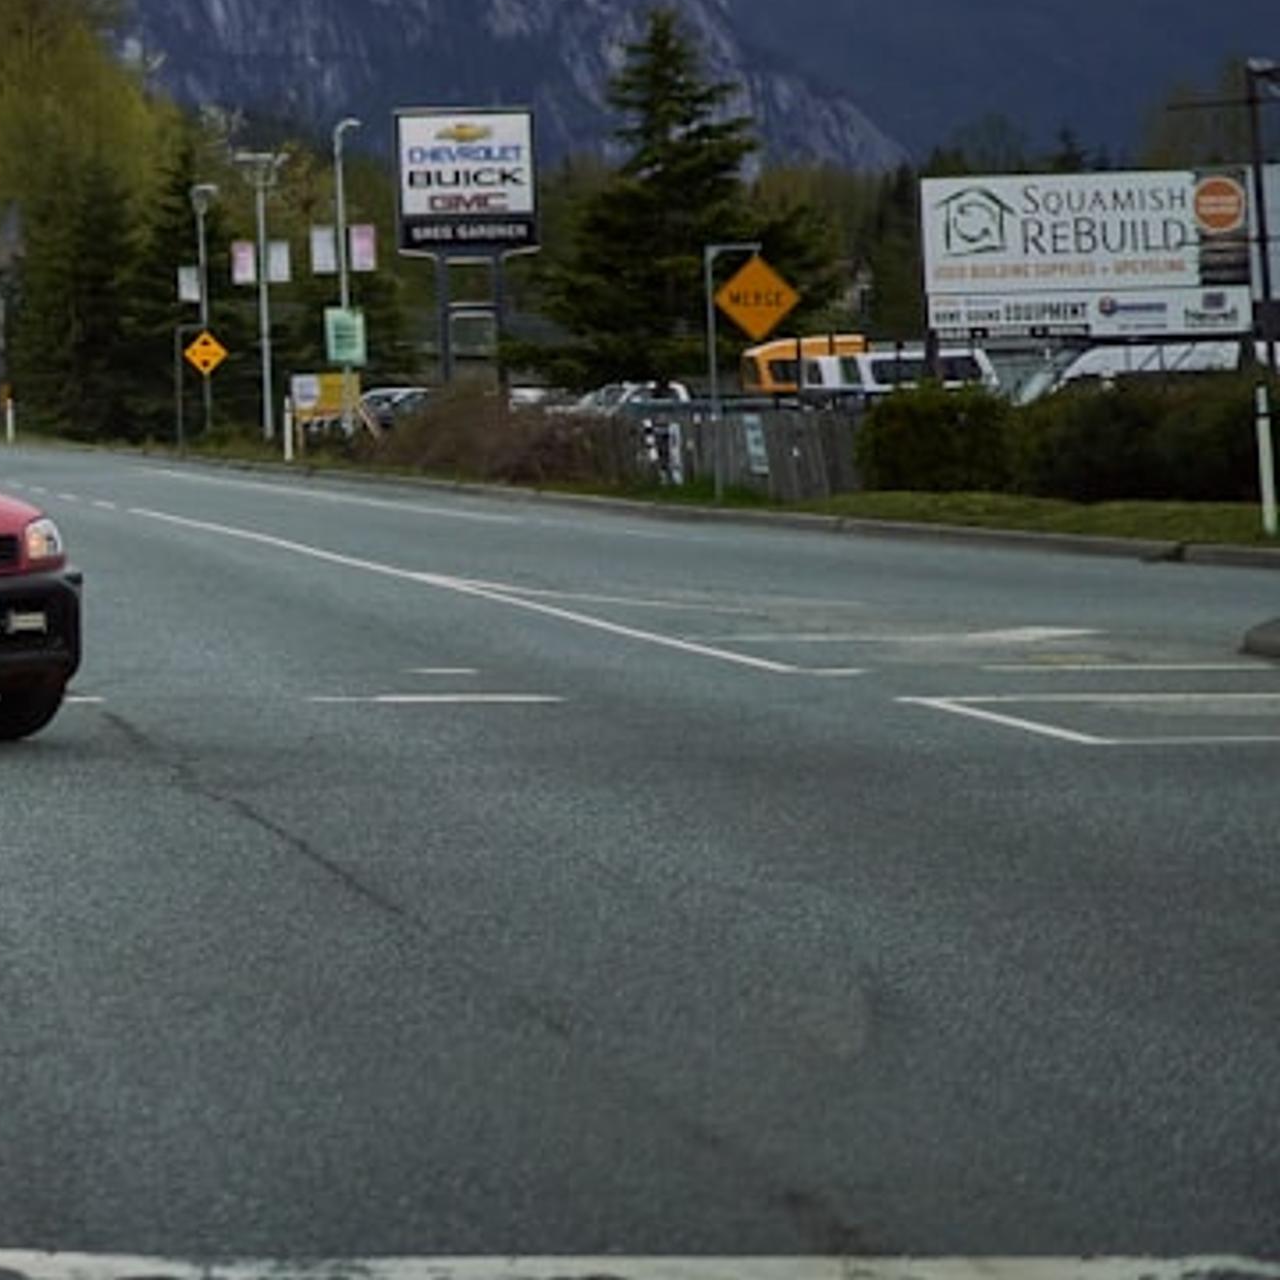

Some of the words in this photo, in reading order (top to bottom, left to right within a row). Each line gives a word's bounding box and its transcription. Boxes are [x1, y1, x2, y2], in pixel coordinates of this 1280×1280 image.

[409, 145, 521, 163] CHEVROLET
[409, 168, 525, 188] BUICK
[429, 192, 508, 211] GMC
[1023, 184, 1186, 215] SQUAMISH
[729, 288, 784, 306] MERGE
[1005, 302, 1088, 321] EQUIPMENT
